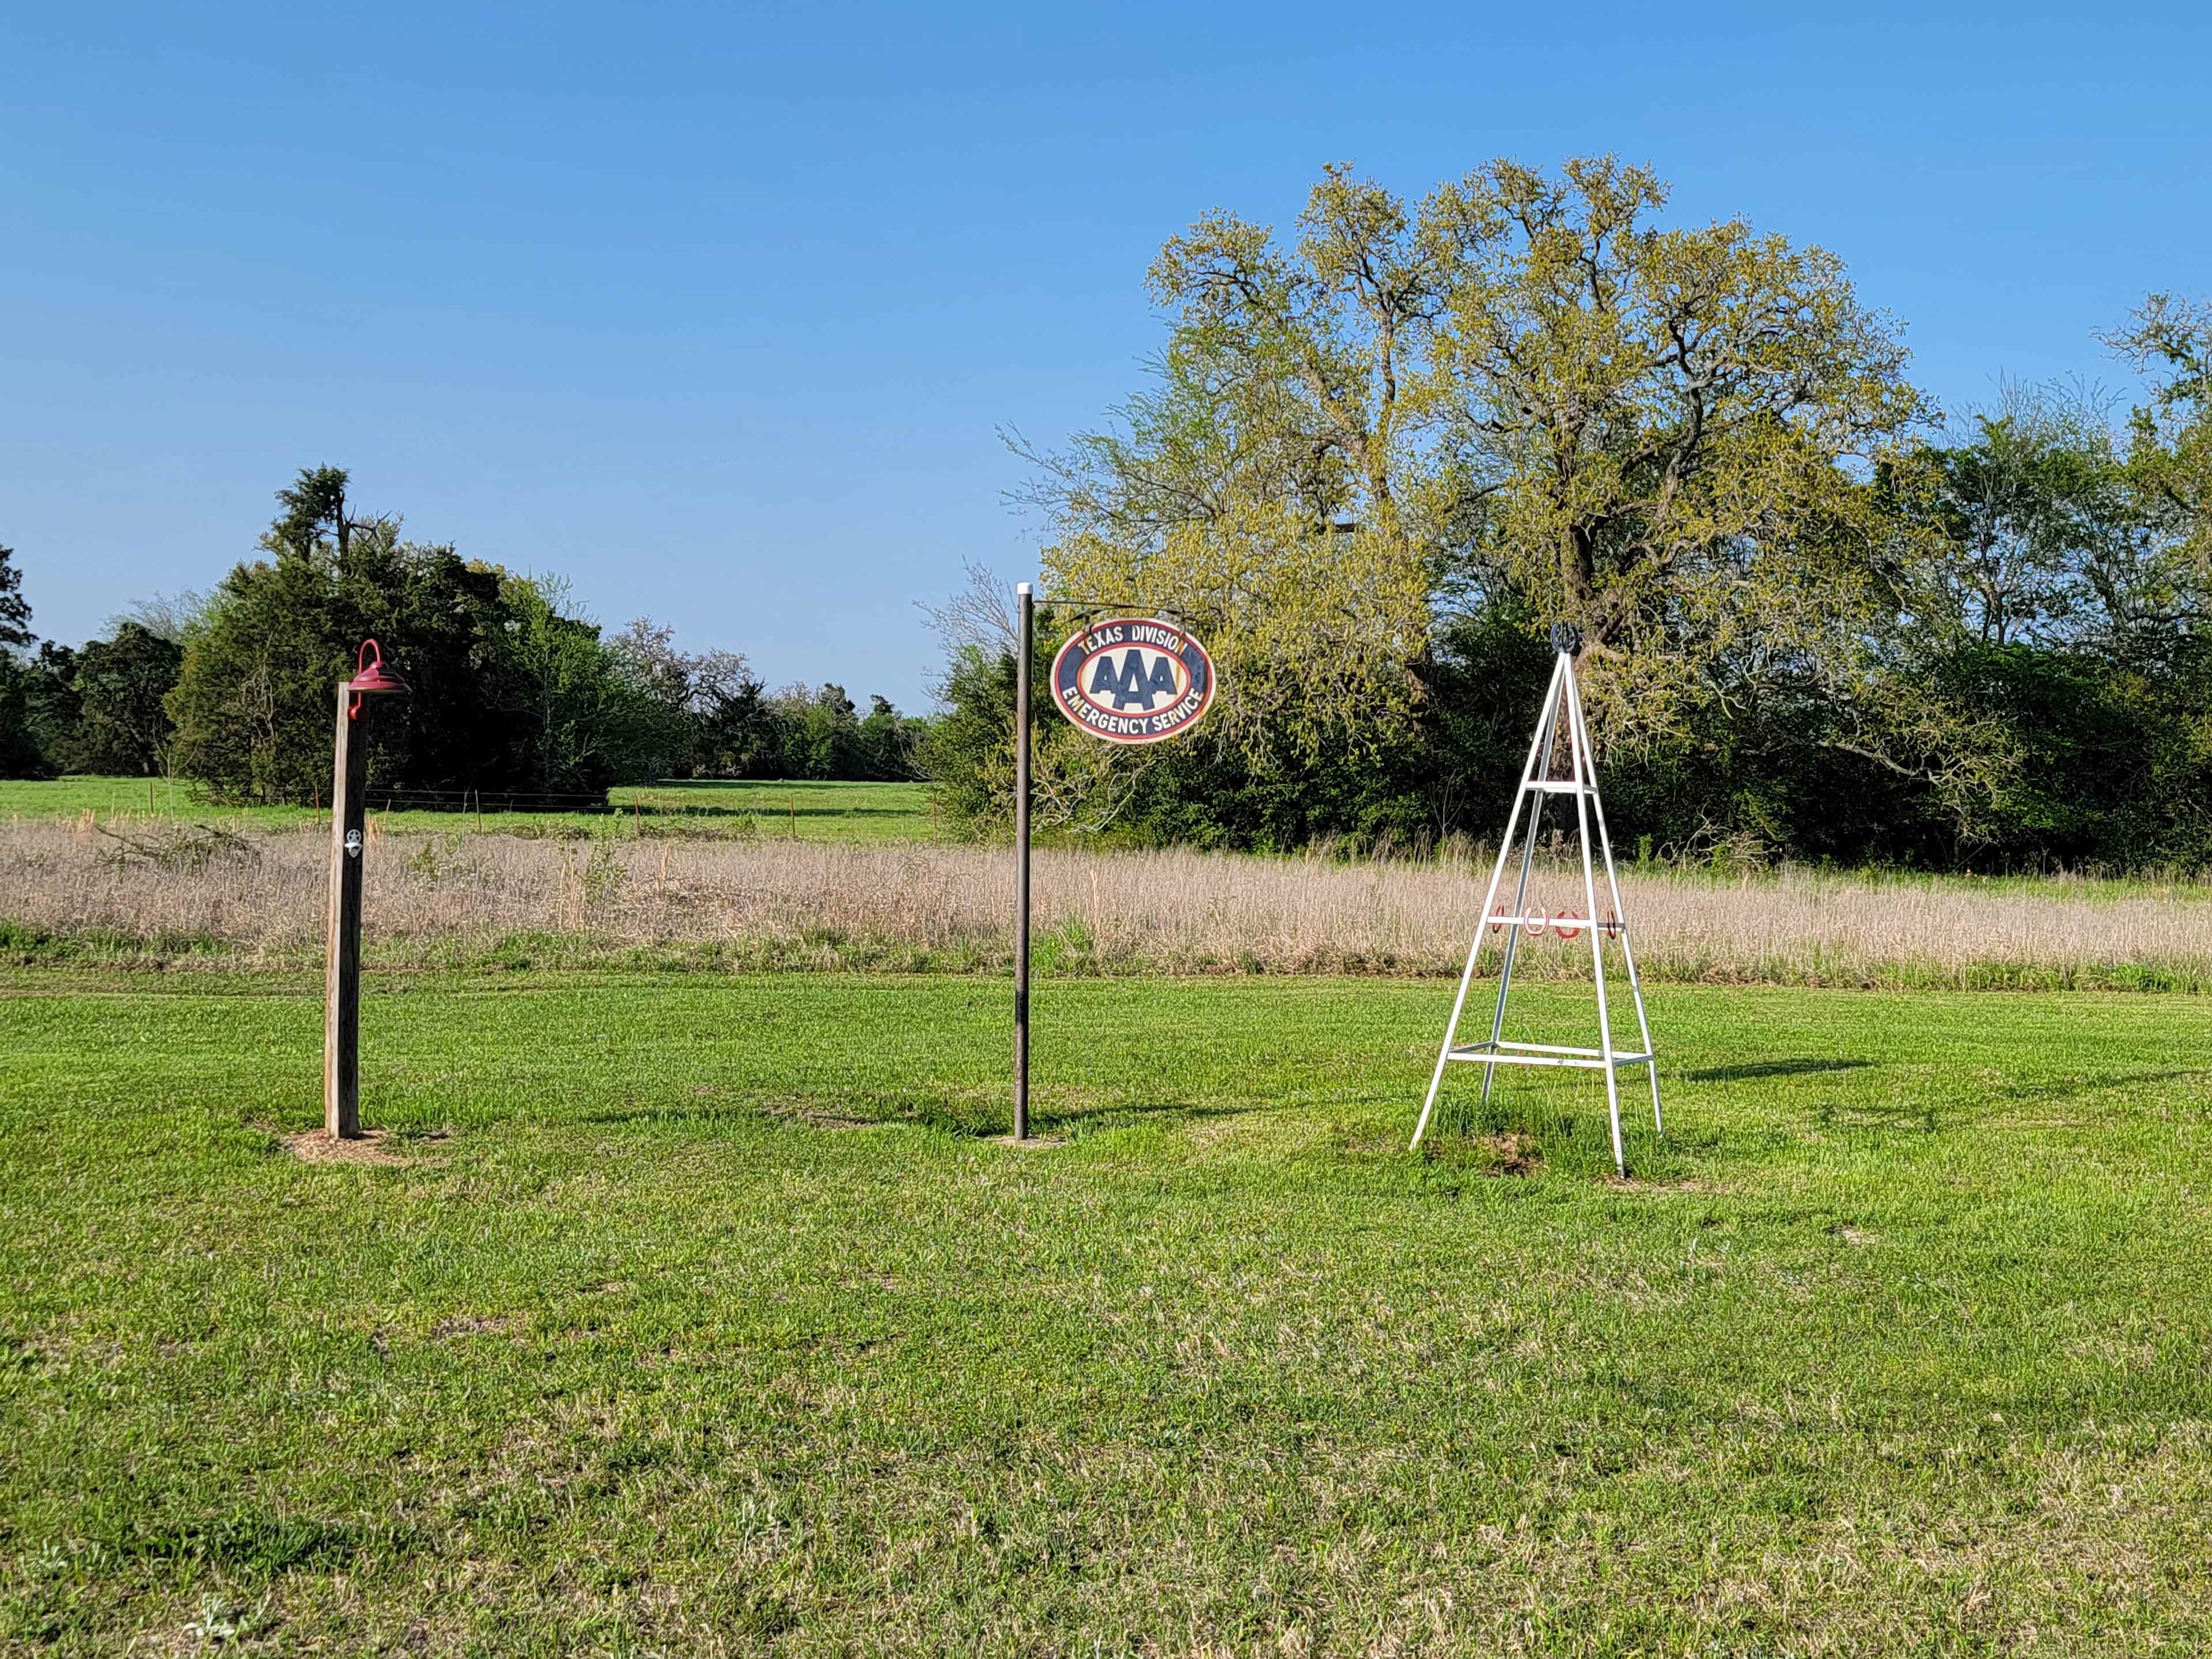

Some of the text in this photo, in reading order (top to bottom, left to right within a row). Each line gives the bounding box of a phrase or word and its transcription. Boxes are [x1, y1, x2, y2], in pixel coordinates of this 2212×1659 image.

[1078, 625, 1188, 656] TEXAS DIVISION
[1089, 649, 1177, 711] AAA
[1062, 686, 1204, 734] EMERGENCY SERVICE
